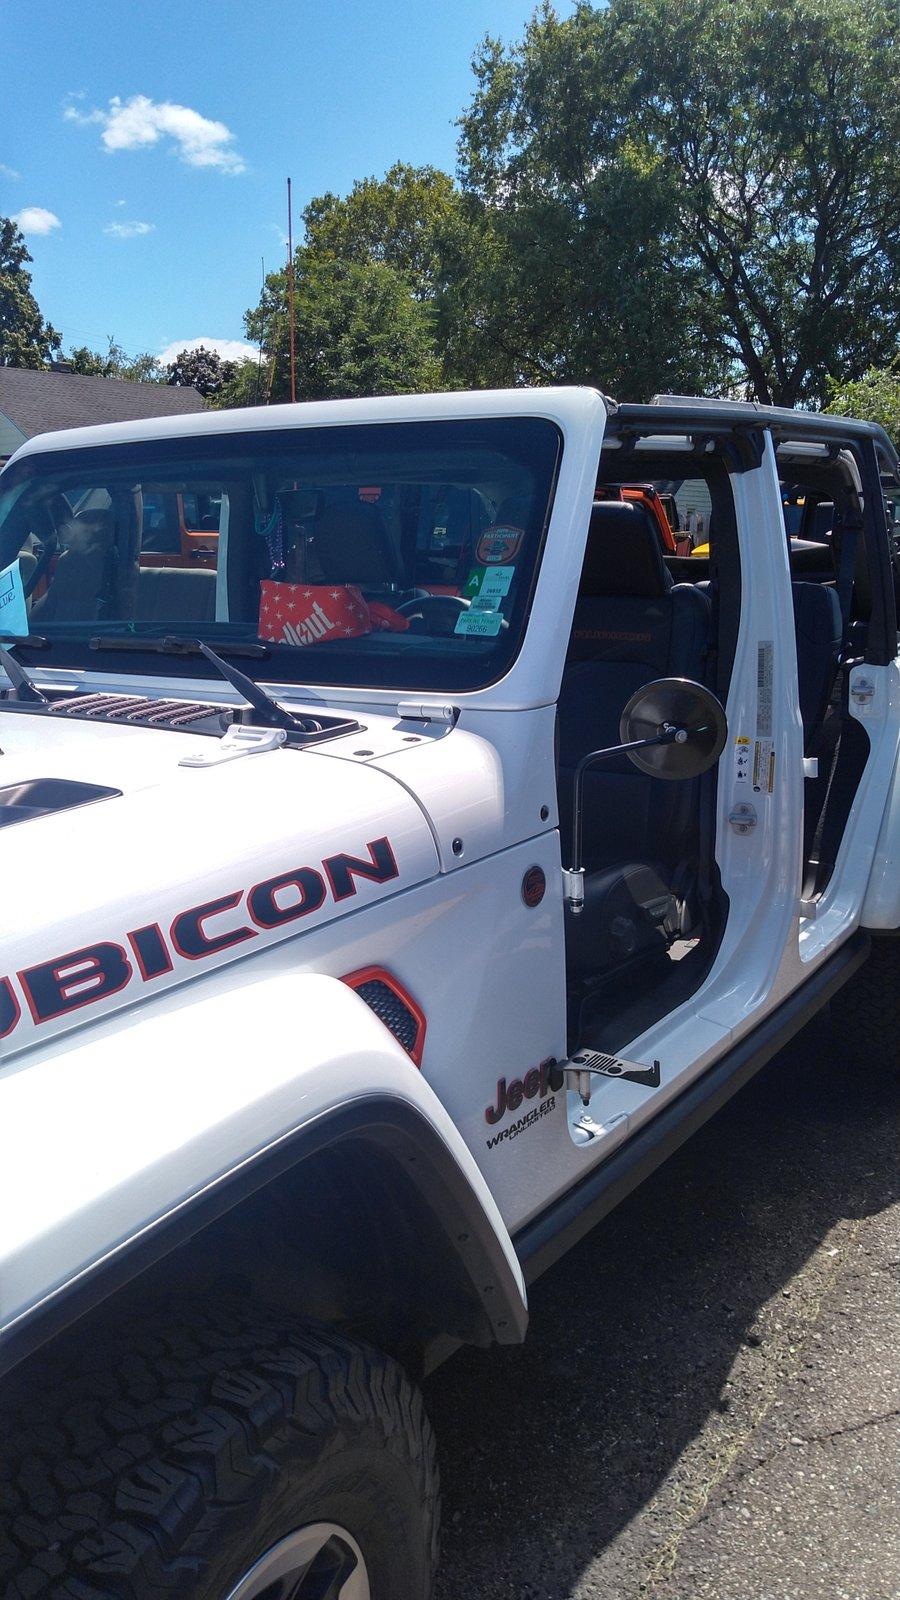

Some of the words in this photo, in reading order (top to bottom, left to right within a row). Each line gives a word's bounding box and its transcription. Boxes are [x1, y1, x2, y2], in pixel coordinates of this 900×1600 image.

[469, 575, 479, 587] A
[268, 601, 336, 647] llout
[0, 836, 399, 1039] BICON
[486, 1096, 556, 1149] WRANGLER
[509, 1104, 556, 1140] UNLIMITED
